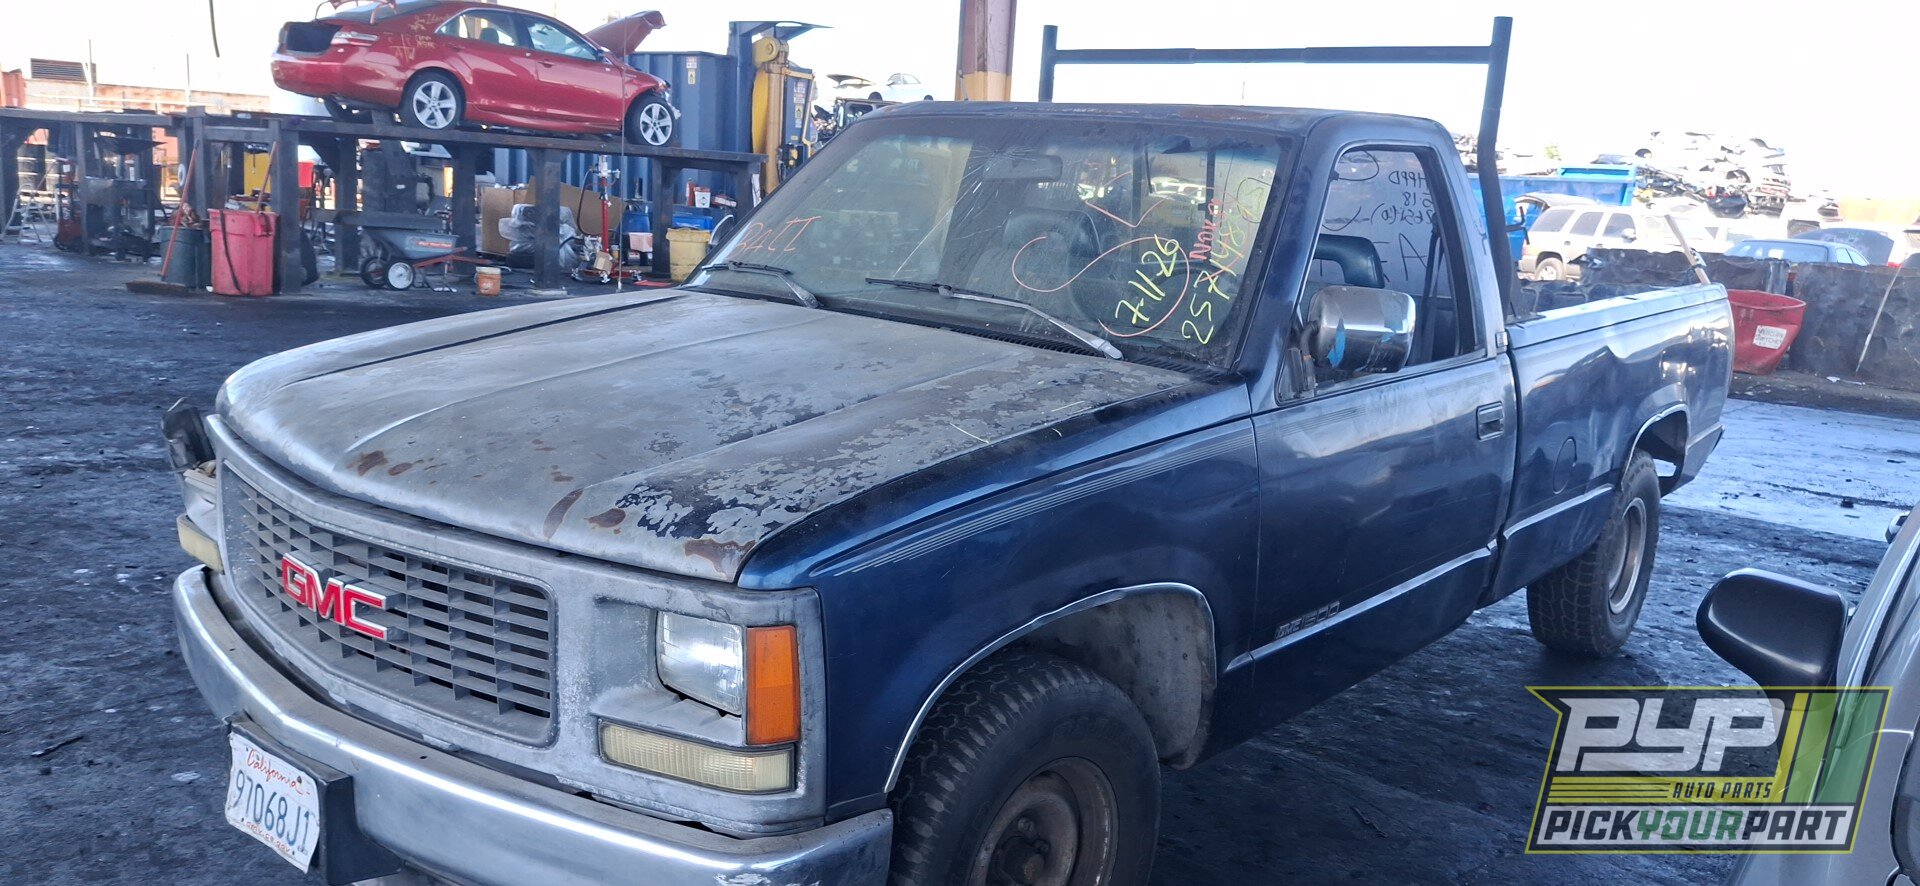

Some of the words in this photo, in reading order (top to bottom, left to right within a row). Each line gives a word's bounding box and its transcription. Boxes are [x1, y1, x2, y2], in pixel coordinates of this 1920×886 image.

[282, 552, 387, 641] GMC
[232, 768, 310, 853] 97068J1
[246, 748, 303, 796] California
